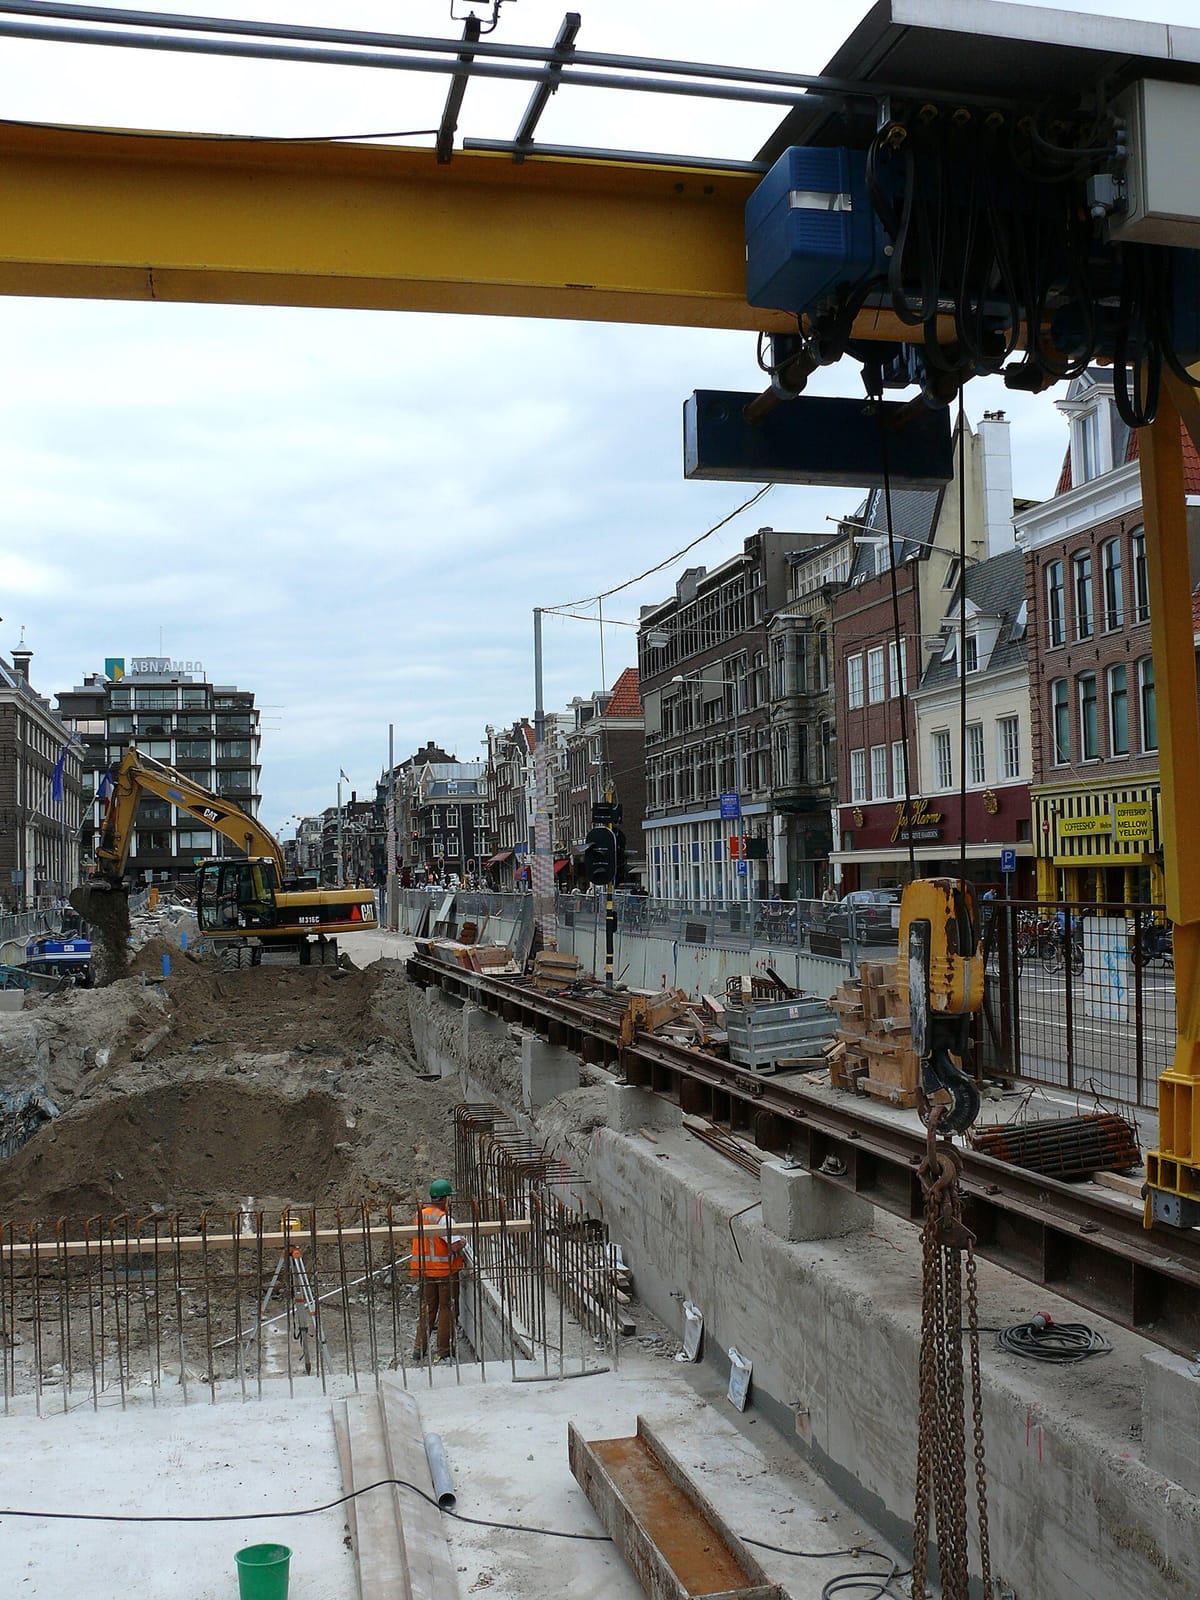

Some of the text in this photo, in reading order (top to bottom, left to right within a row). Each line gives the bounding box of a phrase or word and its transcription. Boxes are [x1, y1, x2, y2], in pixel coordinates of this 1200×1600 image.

[132, 661, 158, 672] ABN
[203, 808, 218, 821] CAT
[1117, 808, 1147, 817] COFFEESHOP
[1064, 821, 1096, 832] COFFEESHOP
[1117, 820, 1148, 829] MELLOW
[1118, 828, 1148, 837] YELLOW
[1004, 851, 1013, 863] P
[360, 903, 374, 922] CAT
